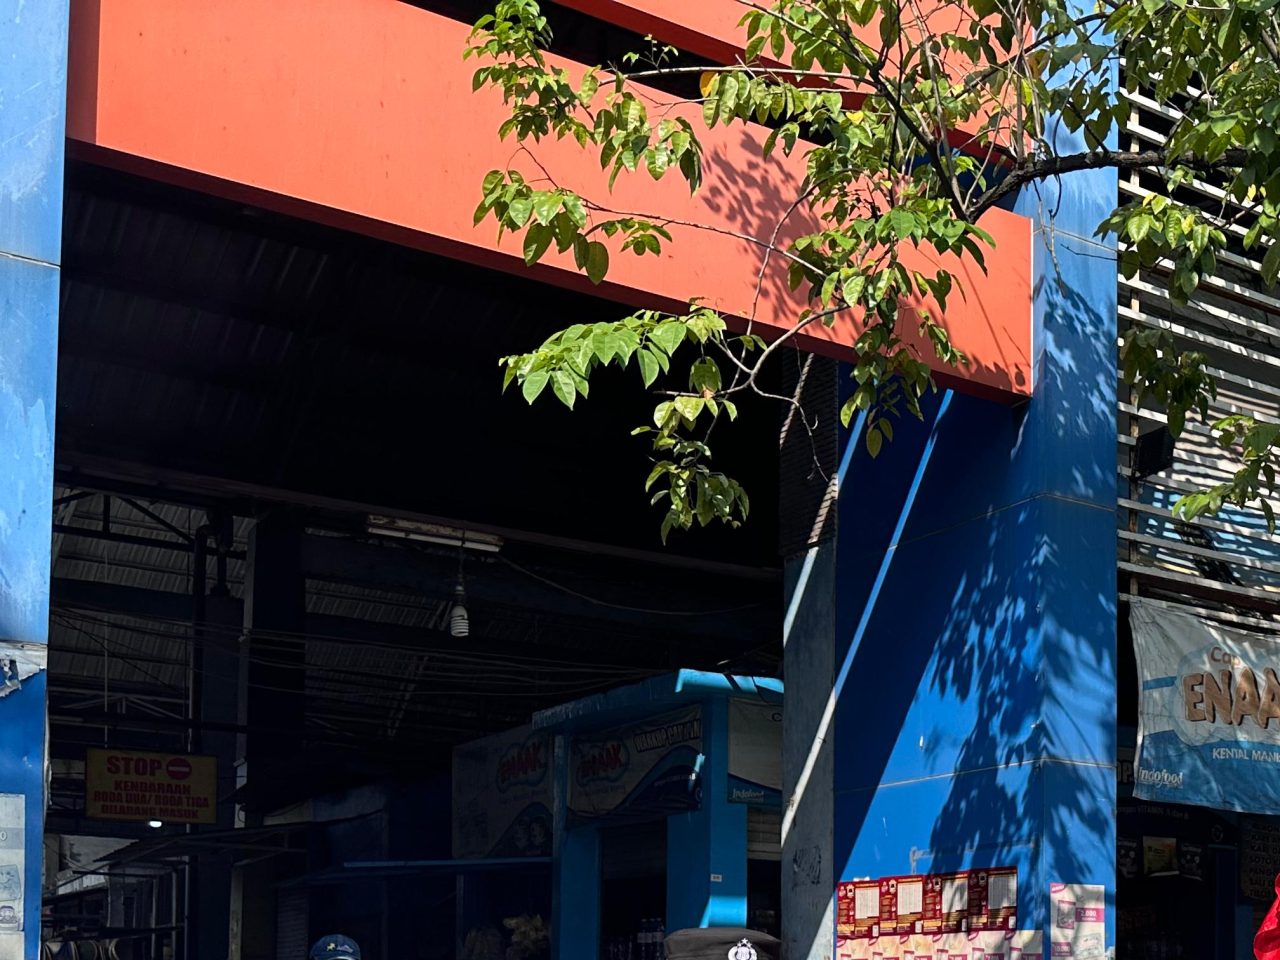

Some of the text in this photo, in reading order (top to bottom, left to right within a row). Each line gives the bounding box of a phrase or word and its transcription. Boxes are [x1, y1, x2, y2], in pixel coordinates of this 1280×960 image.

[1212, 747, 1248, 761] KENTAL
[106, 755, 162, 776] STOP
[1137, 766, 1184, 788] Indofood
[114, 780, 191, 796] KENDARAAN
[183, 796, 209, 809] TIGA
[101, 804, 200, 820] DILARANG MASUK
